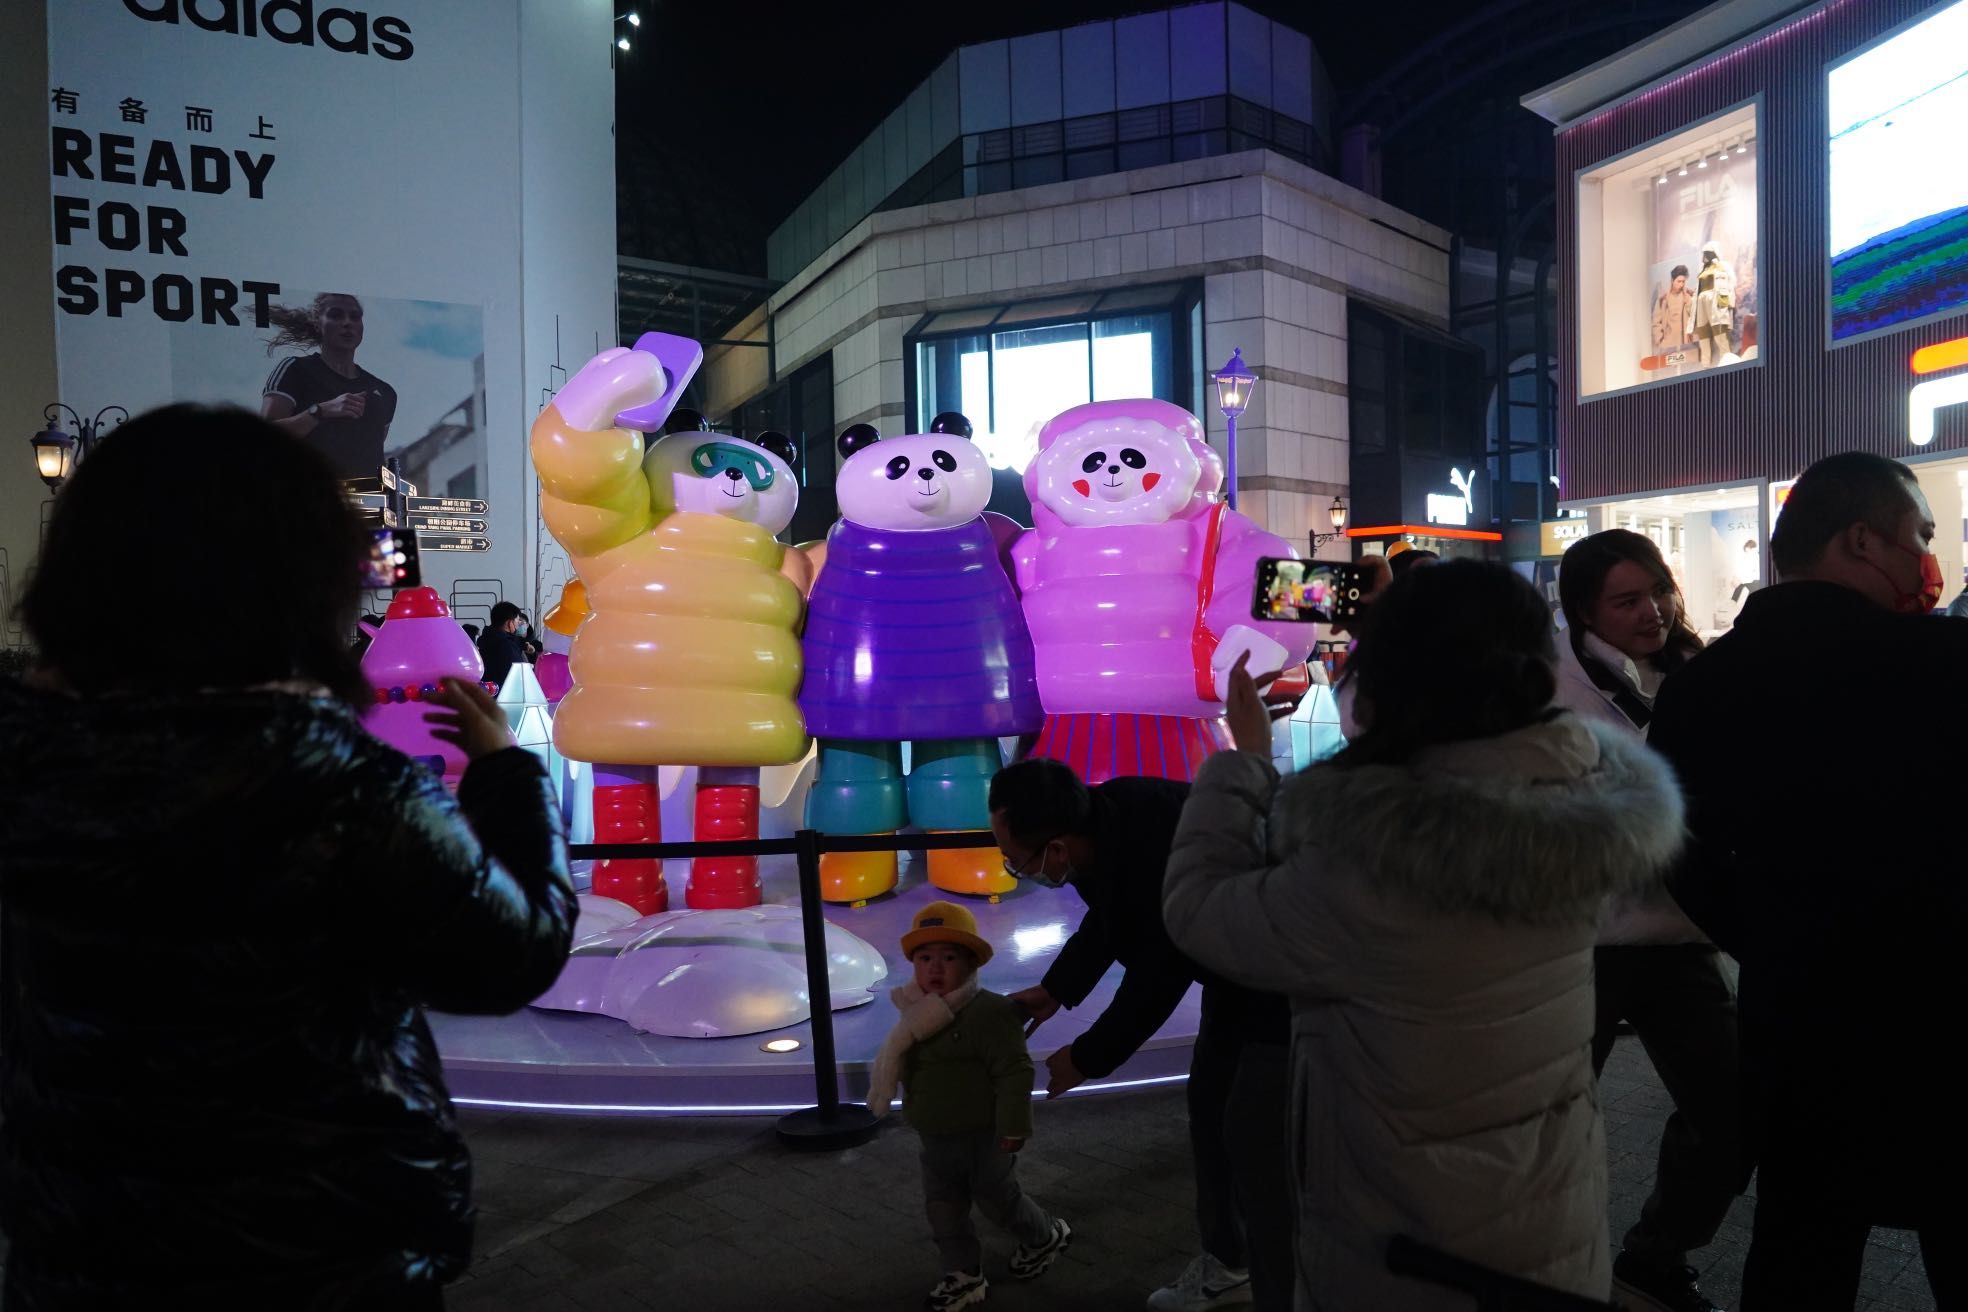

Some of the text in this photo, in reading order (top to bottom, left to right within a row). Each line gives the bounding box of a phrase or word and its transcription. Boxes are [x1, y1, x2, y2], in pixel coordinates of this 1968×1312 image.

[122, 0, 414, 61] adidas
[52, 87, 277, 141] 有备而上
[52, 126, 276, 199] READY
[1680, 173, 1737, 217] FILA
[54, 196, 189, 257] FOR
[57, 264, 281, 329] SPORT
[1667, 353, 1685, 362] FILA
